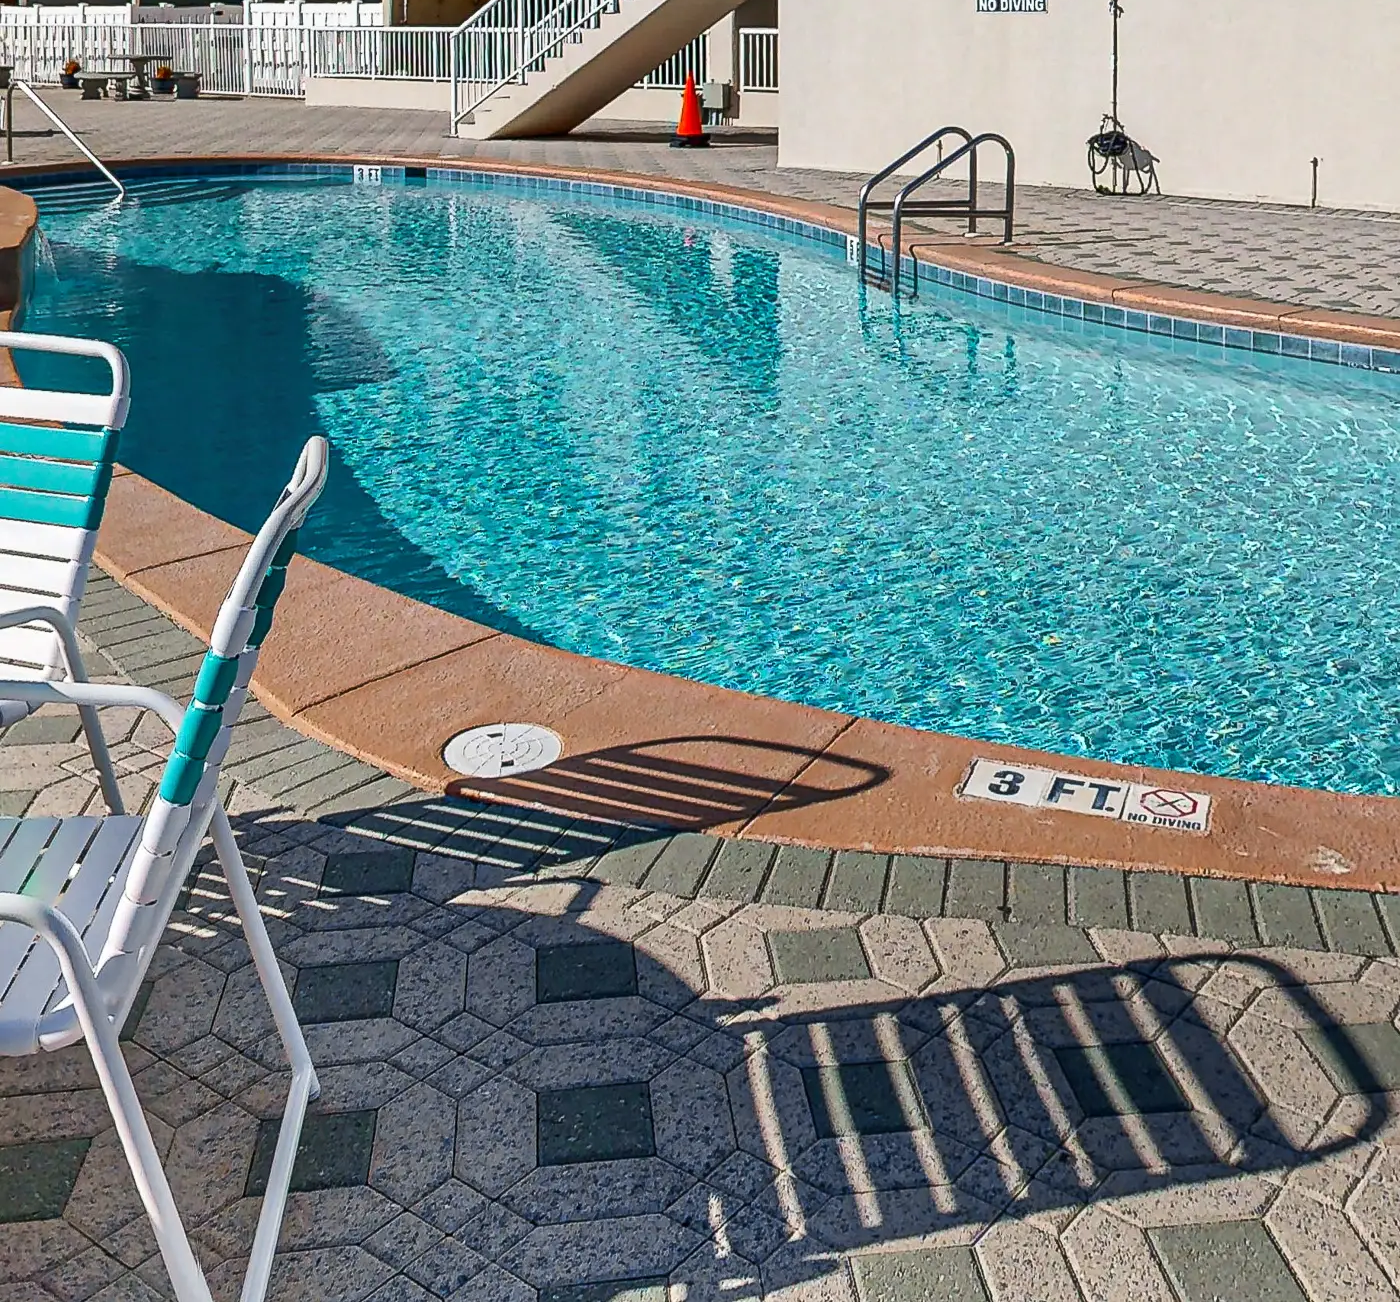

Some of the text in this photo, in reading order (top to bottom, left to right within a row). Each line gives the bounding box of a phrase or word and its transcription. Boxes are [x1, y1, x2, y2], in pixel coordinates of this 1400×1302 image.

[368, 168, 379, 181] FT
[988, 770, 1121, 812] 3 FT.
[1128, 812, 1201, 831] NO DIVING
